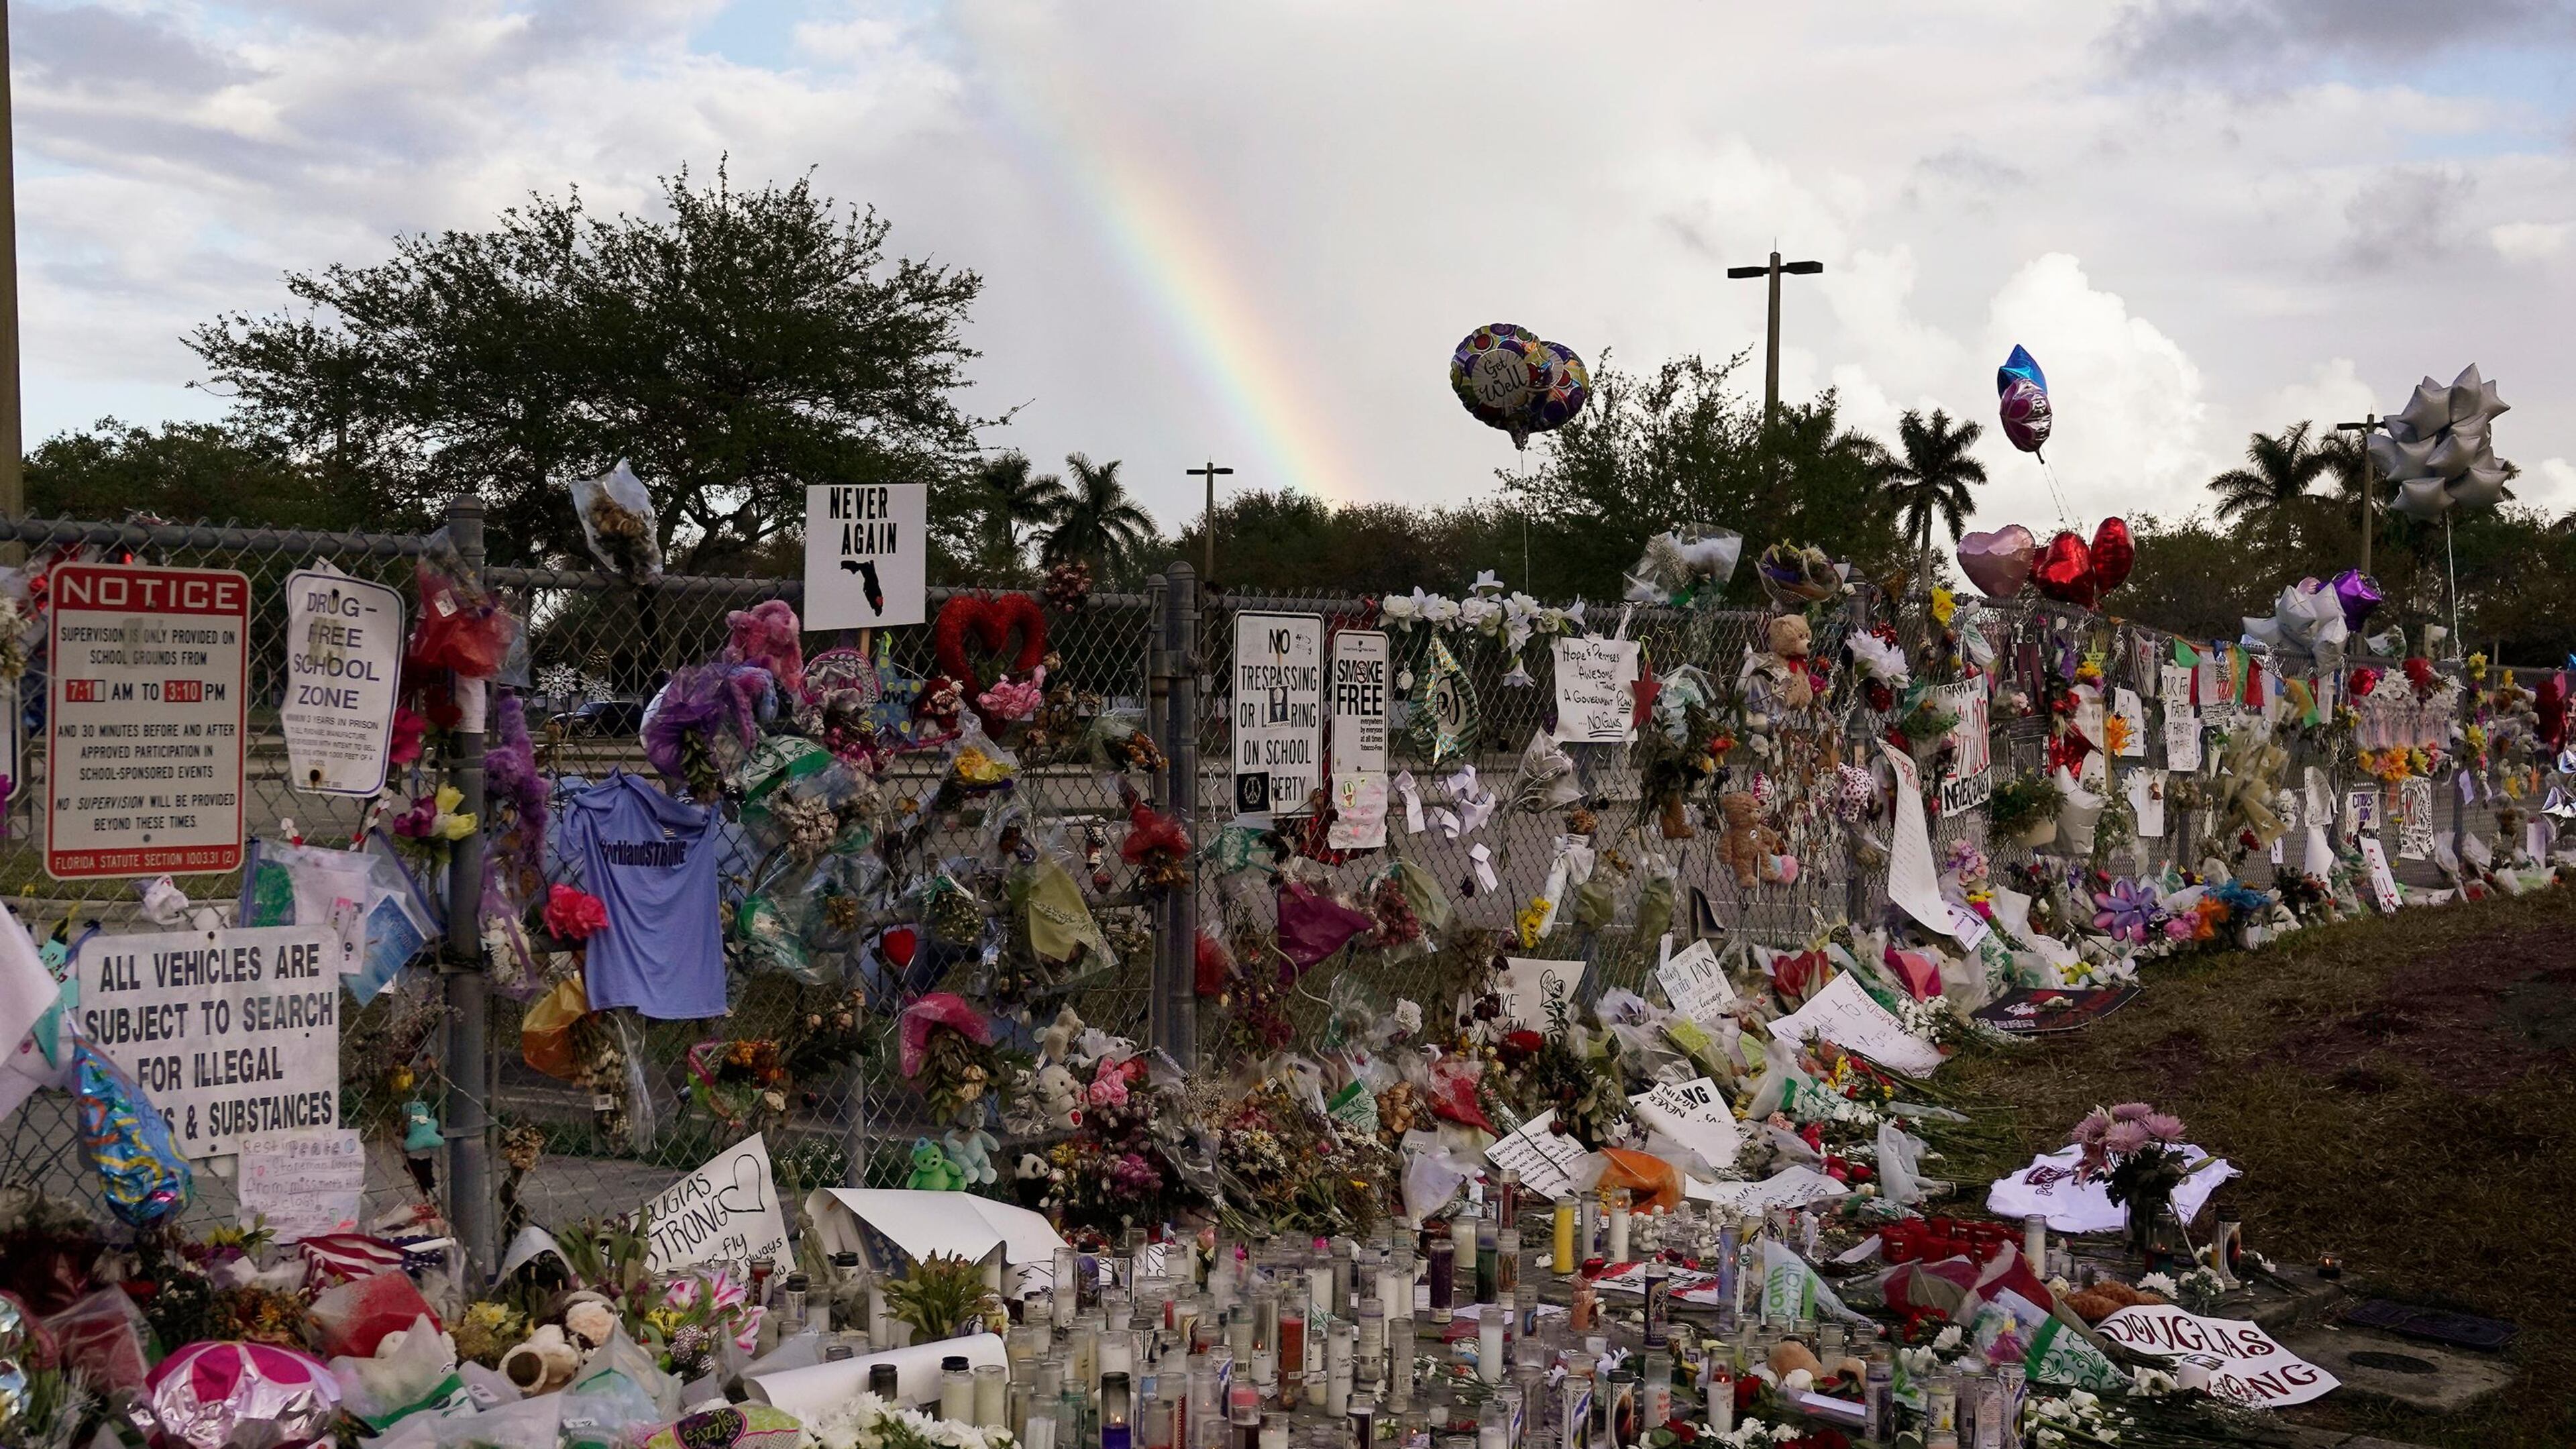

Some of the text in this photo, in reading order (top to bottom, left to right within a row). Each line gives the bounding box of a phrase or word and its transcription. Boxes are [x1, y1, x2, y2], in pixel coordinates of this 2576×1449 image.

[1484, 358, 1508, 378] Get
[1479, 365, 1528, 402] Well
[830, 487, 888, 519] NEVER
[841, 523, 897, 555] AGAIN
[62, 575, 239, 610] NOTICE
[61, 627, 234, 645] SUPERVISION IS ONLY PROVIDED ON
[307, 623, 363, 649] FREE
[1269, 629, 1291, 654] NO
[90, 650, 207, 665] SCHOOL GROUNDS FROM
[293, 652, 380, 682] SCHOOL
[1562, 644, 1587, 667] Hope
[111, 683, 133, 700] AM
[142, 683, 160, 700] TO
[168, 682, 198, 700] 3:10
[205, 684, 225, 701] PM
[1241, 665, 1317, 692] TRESPASSING
[298, 684, 360, 710] ZONE
[1336, 684, 1383, 716] FREE
[1564, 688, 1571, 702] A
[313, 715, 335, 725] YEARS
[337, 718, 346, 726] IN
[348, 719, 378, 730] PRISON
[1240, 702, 1316, 729] OR LRING
[1360, 718, 1383, 726] everywhere
[58, 724, 235, 738] AND 30 MINUTES BEFORE AND AFTER
[80, 745, 213, 759] APPROVED PARTICIPATION IN
[1244, 739, 1311, 765] ON SCHOOL
[80, 765, 213, 781] SCHOOL-SPONSORED EVENTS
[55, 793, 235, 810] NO SUPERVISION WILL BE PROVIDED
[1271, 776, 1306, 801] PERTY
[94, 815, 197, 830] BEYOND THESE TIMES.
[55, 850, 235, 870] FLORIDA STATUTE SECTION 1003.31 (2)
[99, 943, 320, 992] ALL VEHICLES ARE
[85, 991, 333, 1045] SUBJECT TO SEARCH
[138, 1046, 284, 1093] FOR ILLEGAL
[1648, 1092, 1686, 1118] NEVER
[1662, 1086, 1699, 1110] AGAIN
[185, 1104, 199, 1140] &
[209, 1090, 333, 1137] SUBSTANCES
[243, 1139, 278, 1154] Rest
[722, 1234, 747, 1260] fly
[744, 1237, 783, 1268] always
[2098, 1313, 2275, 1359] DOUGLAS
